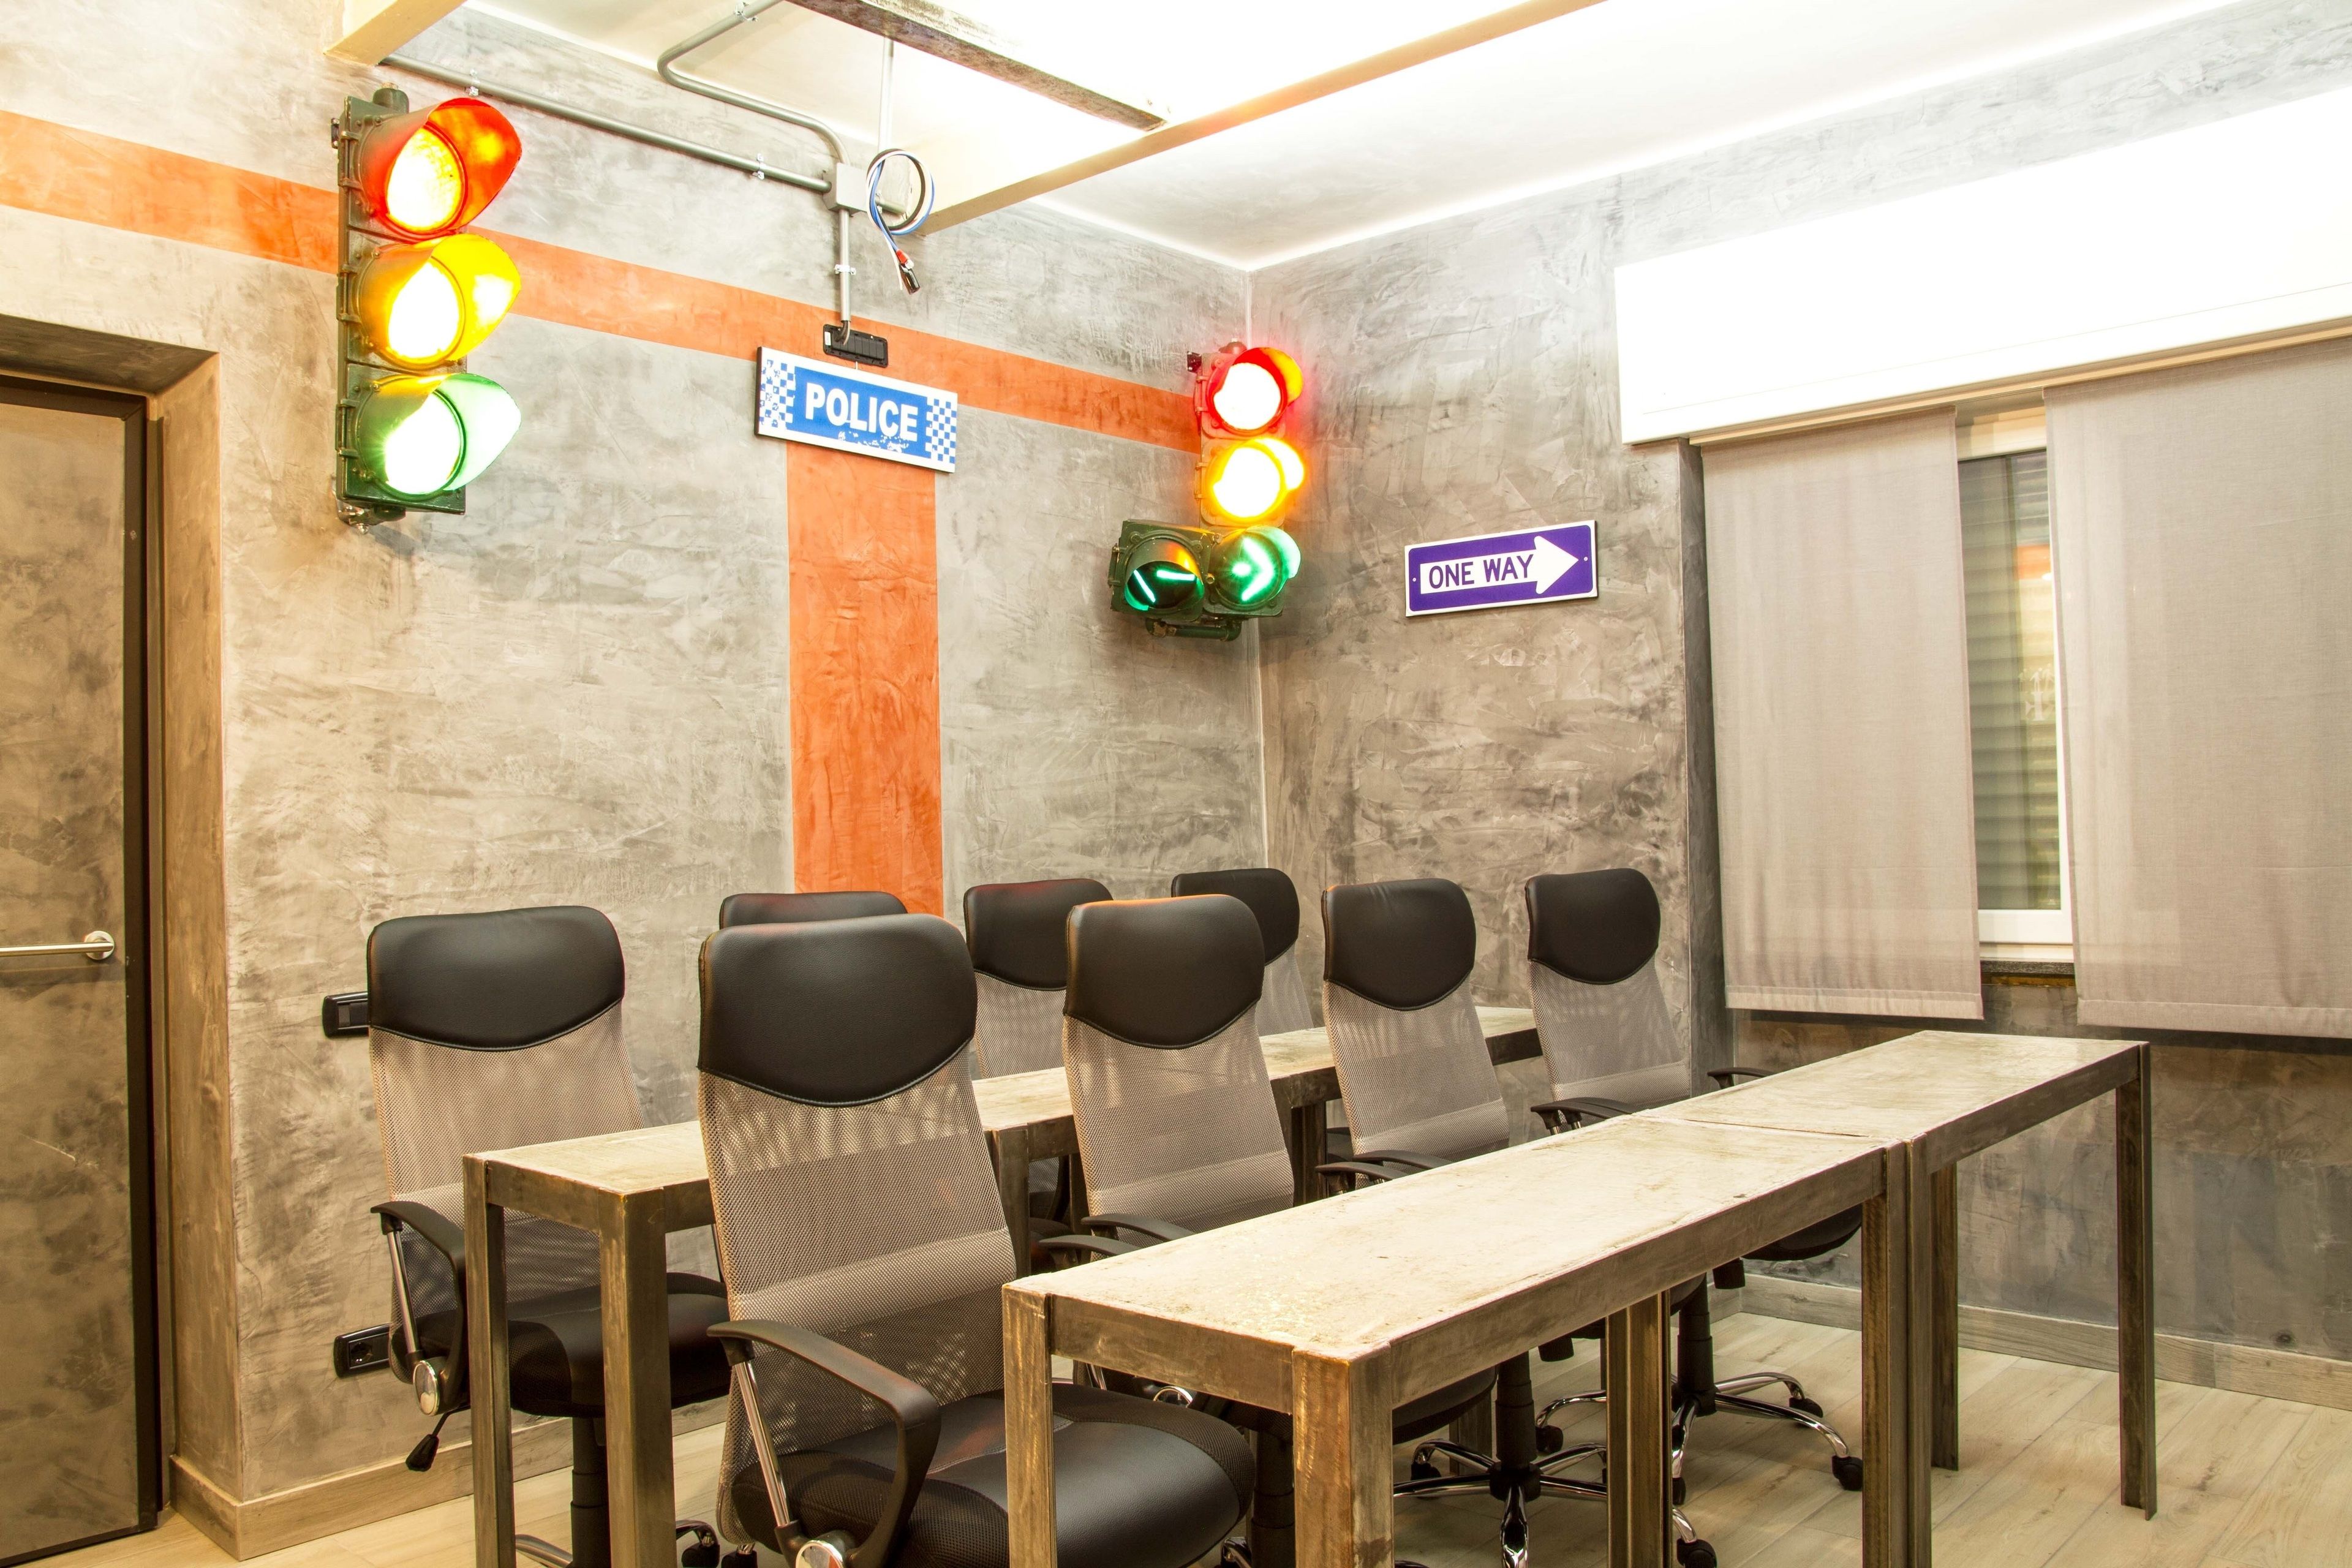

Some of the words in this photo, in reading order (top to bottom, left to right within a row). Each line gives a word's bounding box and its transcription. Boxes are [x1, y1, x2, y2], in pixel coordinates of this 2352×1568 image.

[805, 383, 918, 442] POLICE
[1429, 562, 1474, 589] ONE
[1483, 554, 1534, 582] WAY
